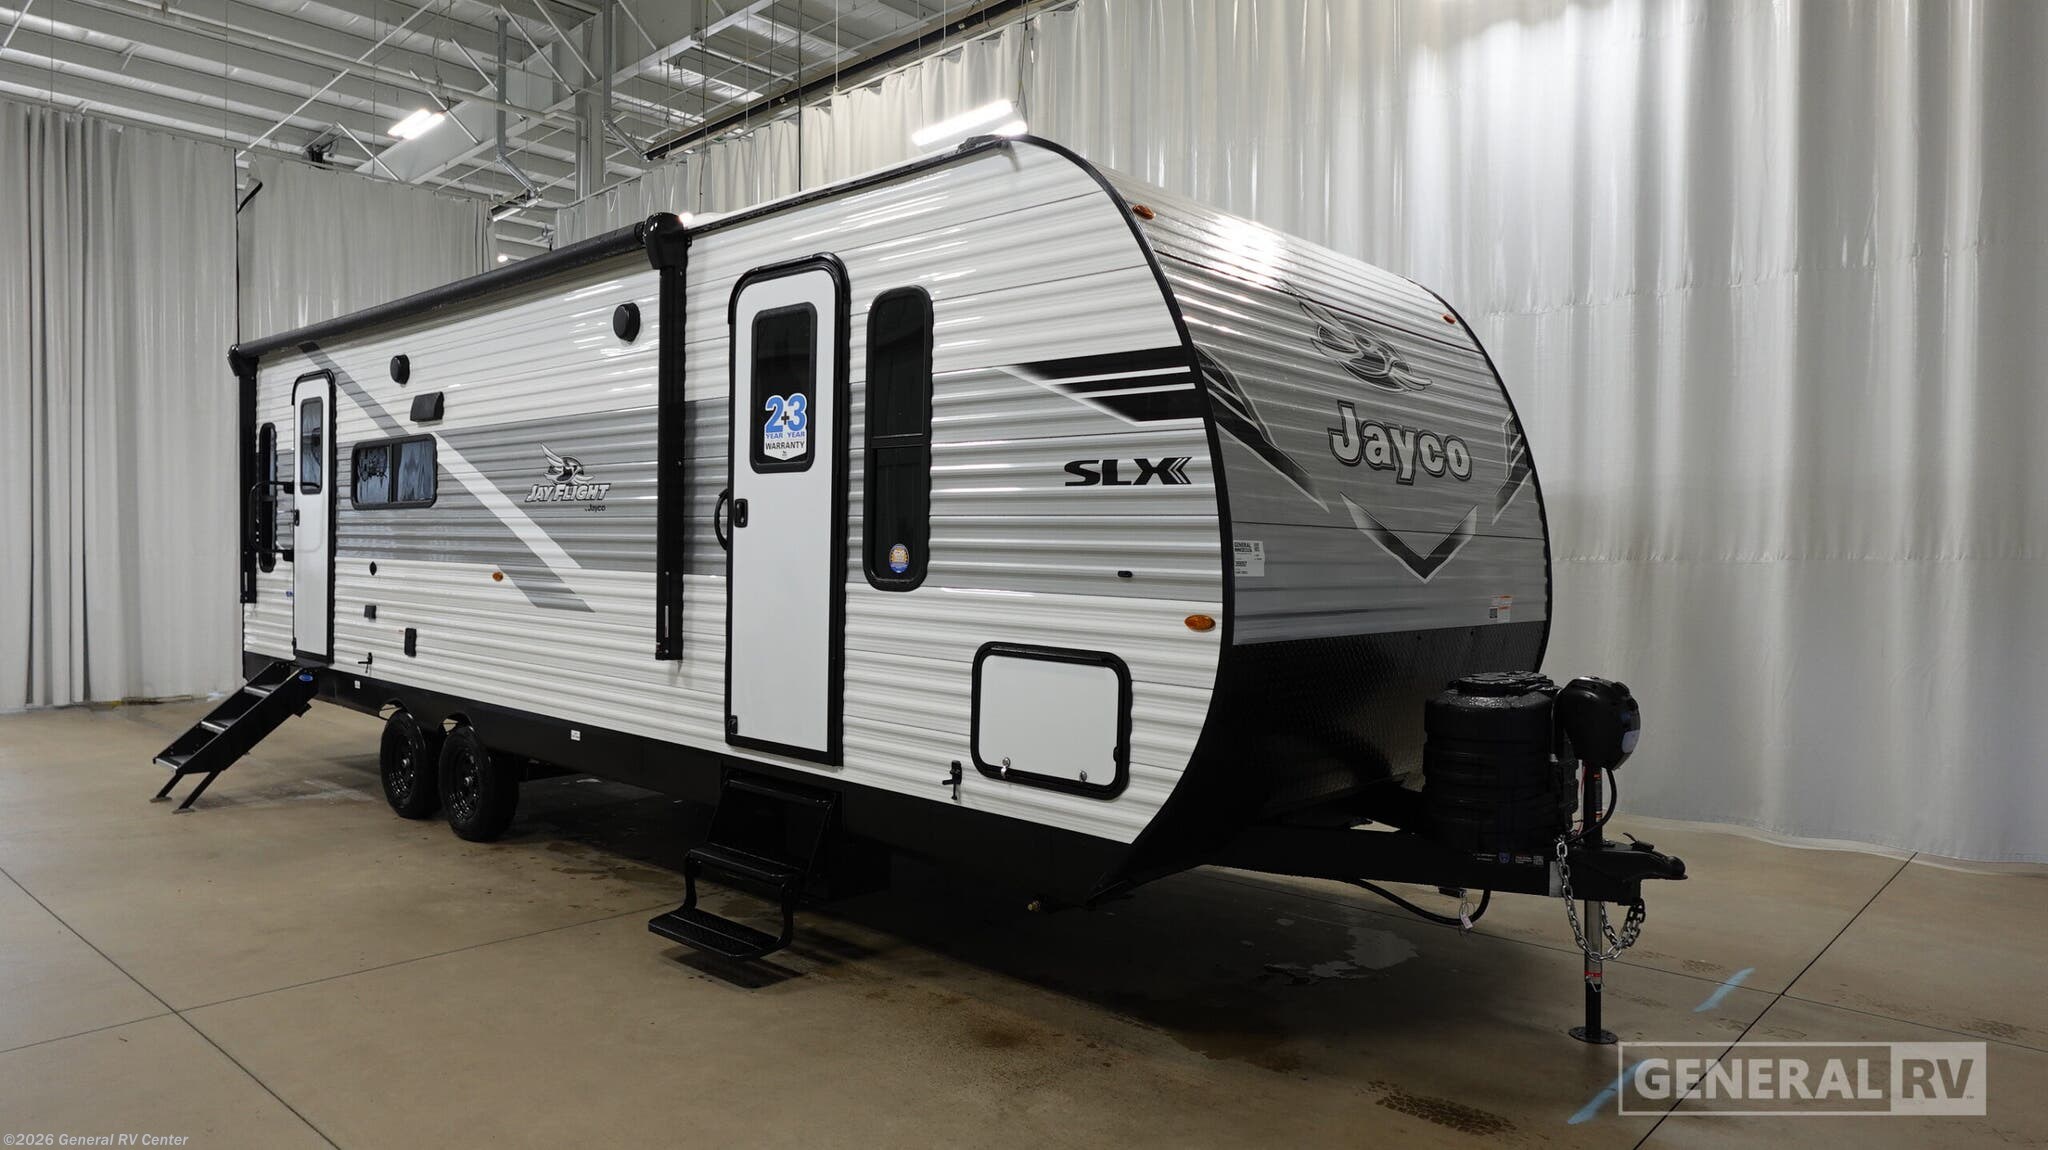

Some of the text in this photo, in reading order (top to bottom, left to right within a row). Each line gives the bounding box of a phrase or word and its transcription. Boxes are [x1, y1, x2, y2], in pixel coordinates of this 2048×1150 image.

[766, 441, 805, 450] WARRANTY
[1327, 400, 1472, 485] Jayco
[1064, 457, 1192, 486] SLX
[525, 483, 611, 502] JAY FLIGHT
